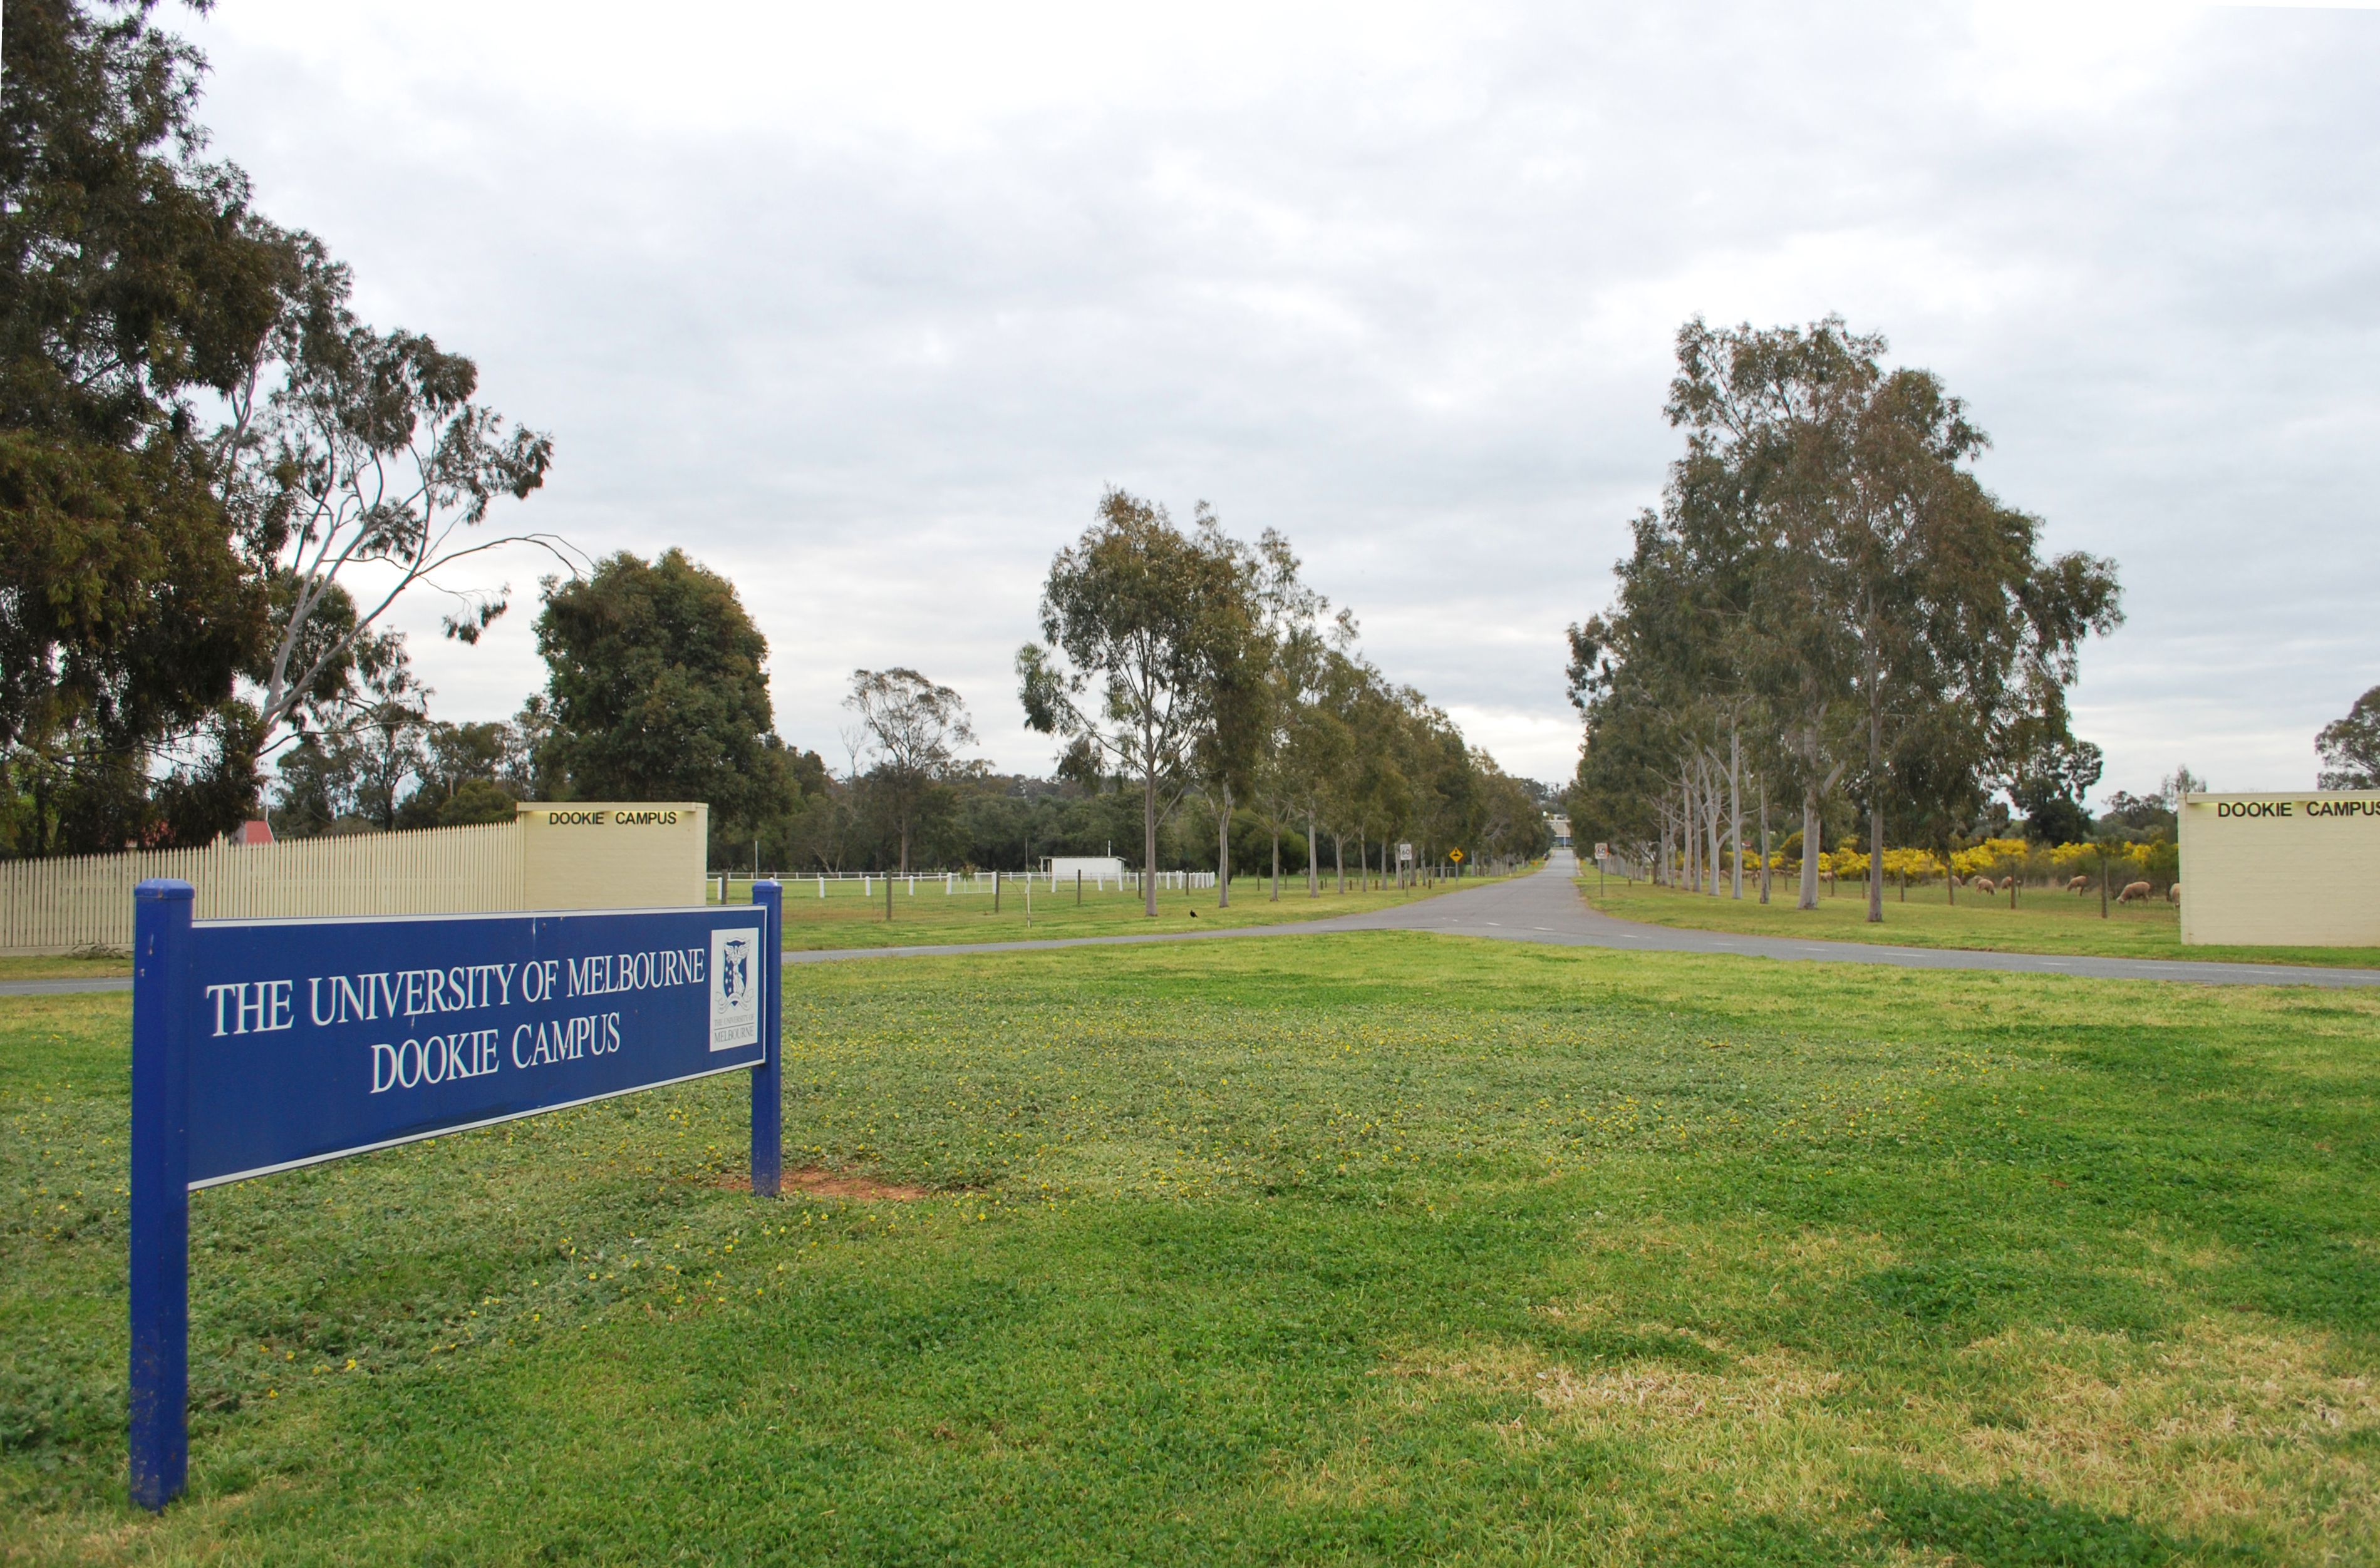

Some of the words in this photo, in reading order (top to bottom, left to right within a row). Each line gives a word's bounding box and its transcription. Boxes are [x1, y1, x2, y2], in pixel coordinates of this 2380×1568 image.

[2218, 802, 2292, 817] DOOKIE
[549, 812, 604, 825] DOOKIE
[615, 812, 676, 825] CAMPUS
[205, 979, 294, 1037] THE
[308, 962, 519, 1027] UNIVERSITY
[522, 959, 559, 1003] OF
[567, 947, 705, 997] MELBOURNE
[724, 1015, 748, 1025] UNIVERSITY
[715, 1026, 754, 1043] MELBOURNE
[370, 1028, 499, 1094] DOOKIE
[512, 1011, 621, 1069] CAMPUS
